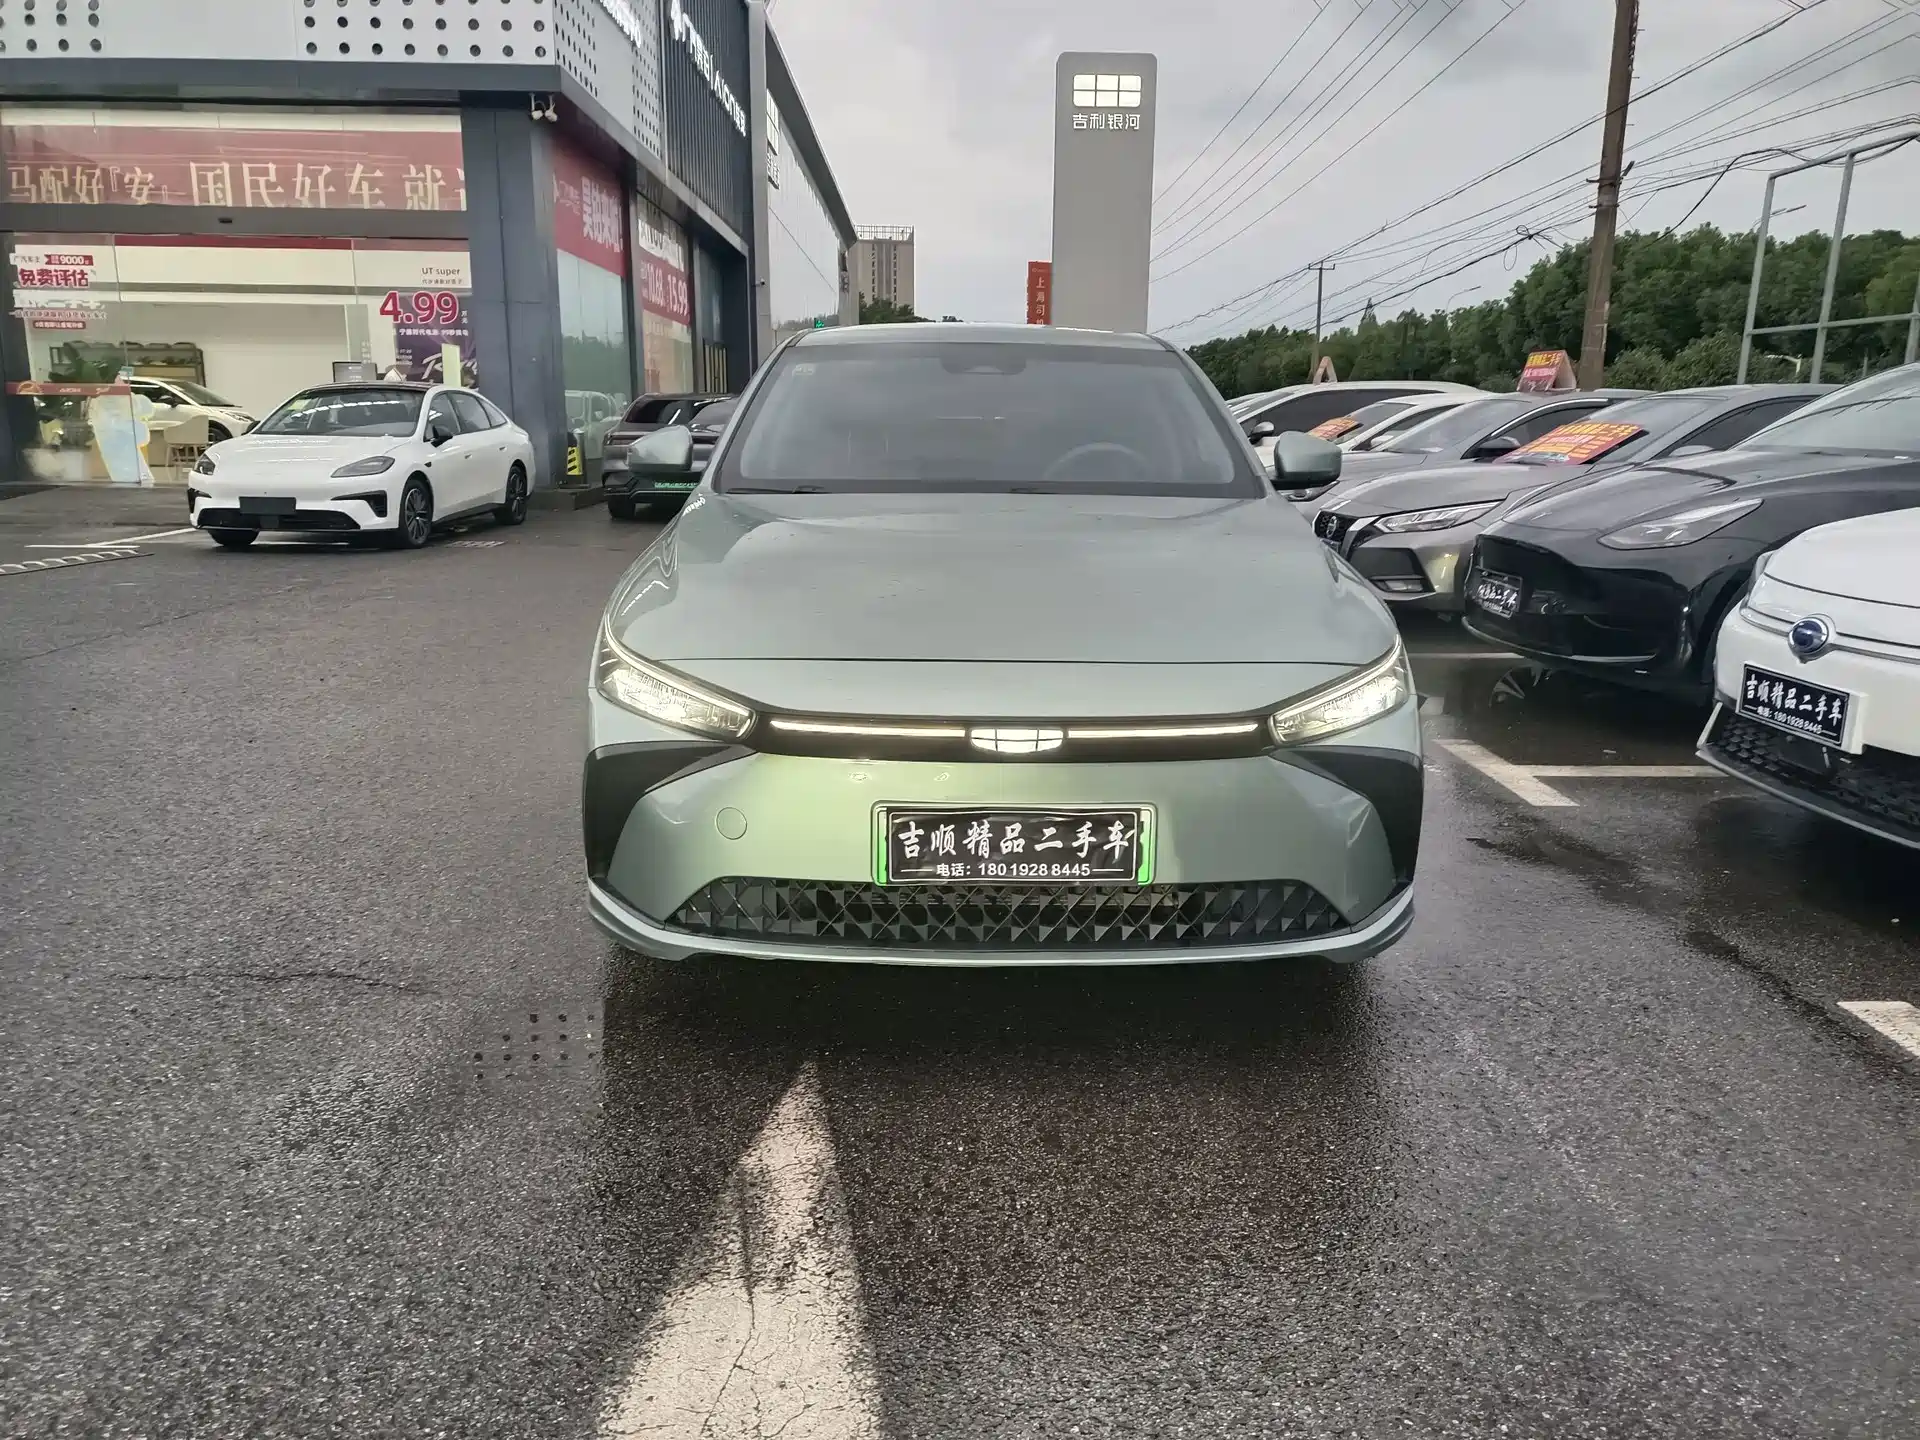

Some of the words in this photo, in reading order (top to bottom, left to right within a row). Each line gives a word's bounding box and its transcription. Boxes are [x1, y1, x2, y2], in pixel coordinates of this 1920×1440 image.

[1072, 113, 1141, 130] 吉利银河
[59, 255, 85, 265] 9000
[19, 267, 89, 288] 免费评估
[421, 267, 434, 276] UT
[435, 267, 461, 277] super
[667, 274, 689, 317] 15.99
[379, 290, 459, 325] 4.99
[1746, 673, 1842, 727] 吉顺精品二手车
[898, 819, 1136, 860] 吉顺精品二手车
[978, 863, 1007, 877] 180
[1009, 863, 1048, 877] 1928
[1051, 863, 1091, 877] 8445
